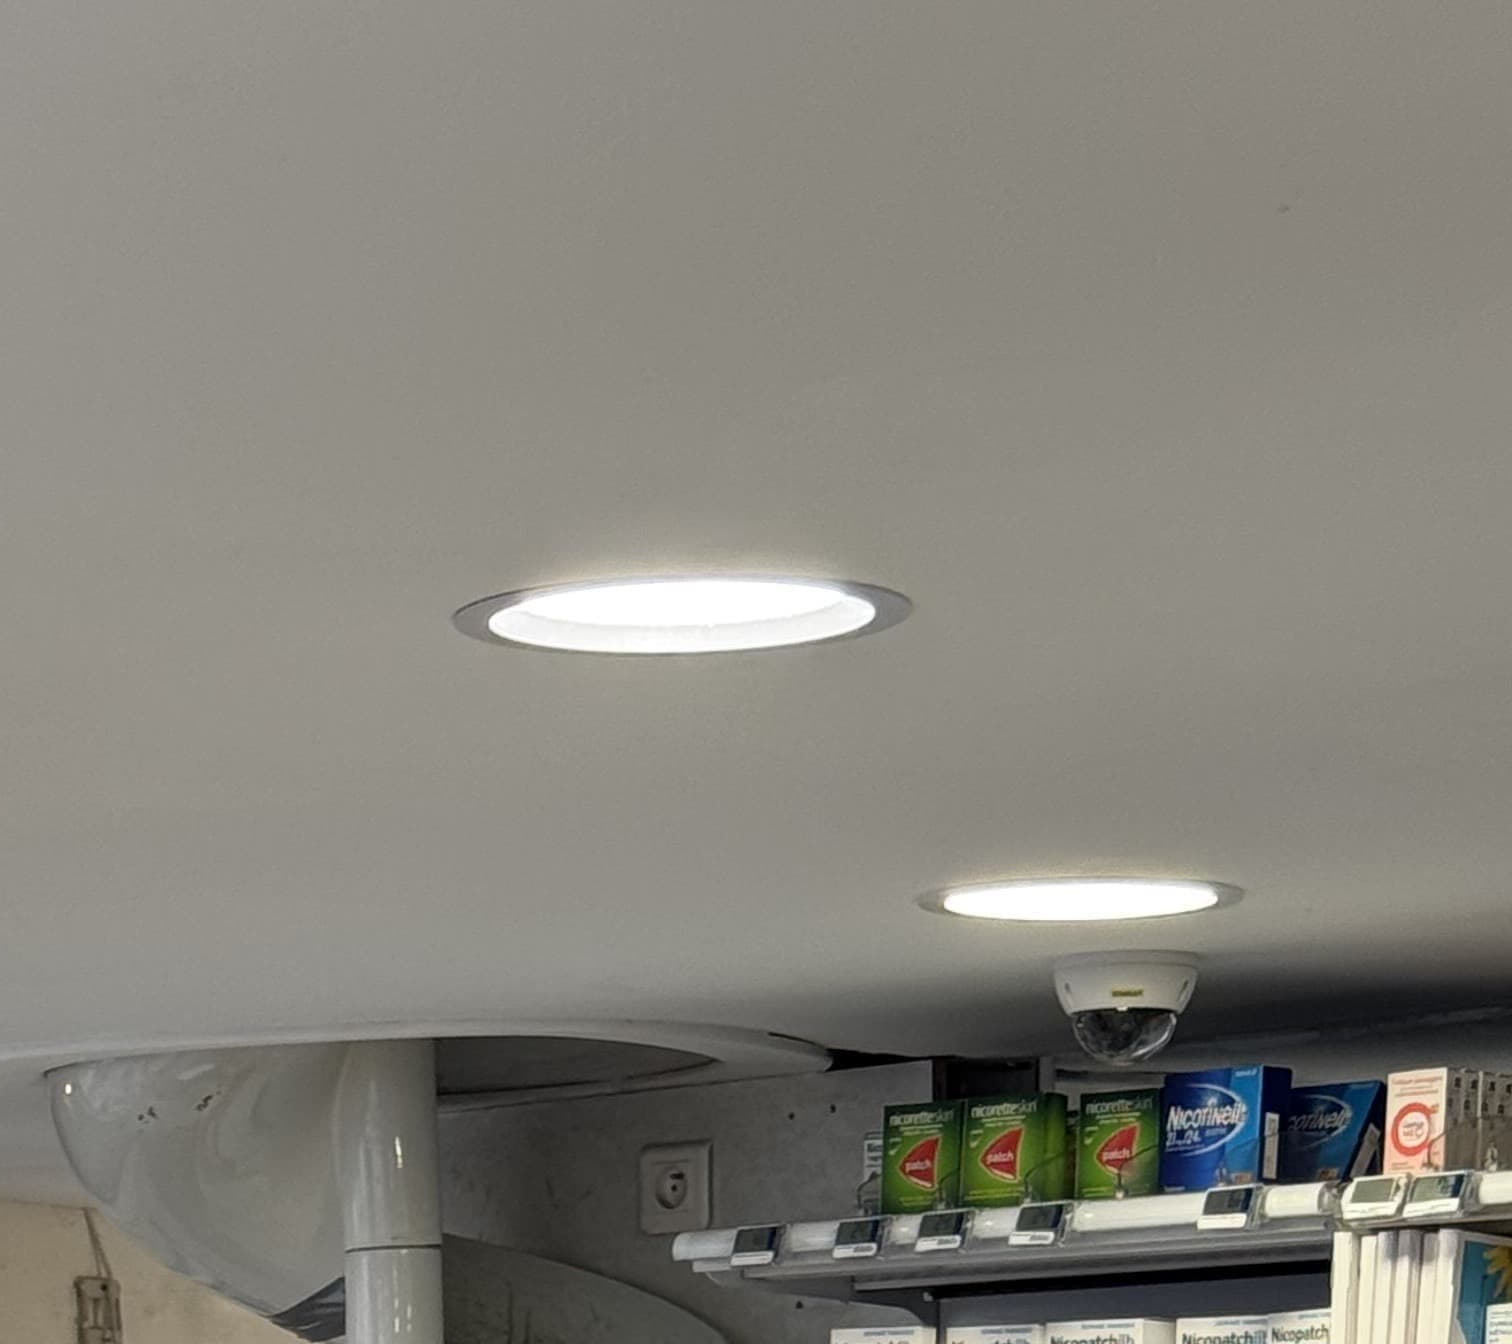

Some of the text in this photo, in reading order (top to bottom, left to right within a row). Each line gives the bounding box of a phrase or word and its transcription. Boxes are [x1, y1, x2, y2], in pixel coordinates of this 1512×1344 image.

[986, 1151, 1014, 1164] patch
[1102, 1149, 1130, 1162] patch
[905, 1160, 932, 1173] patch
